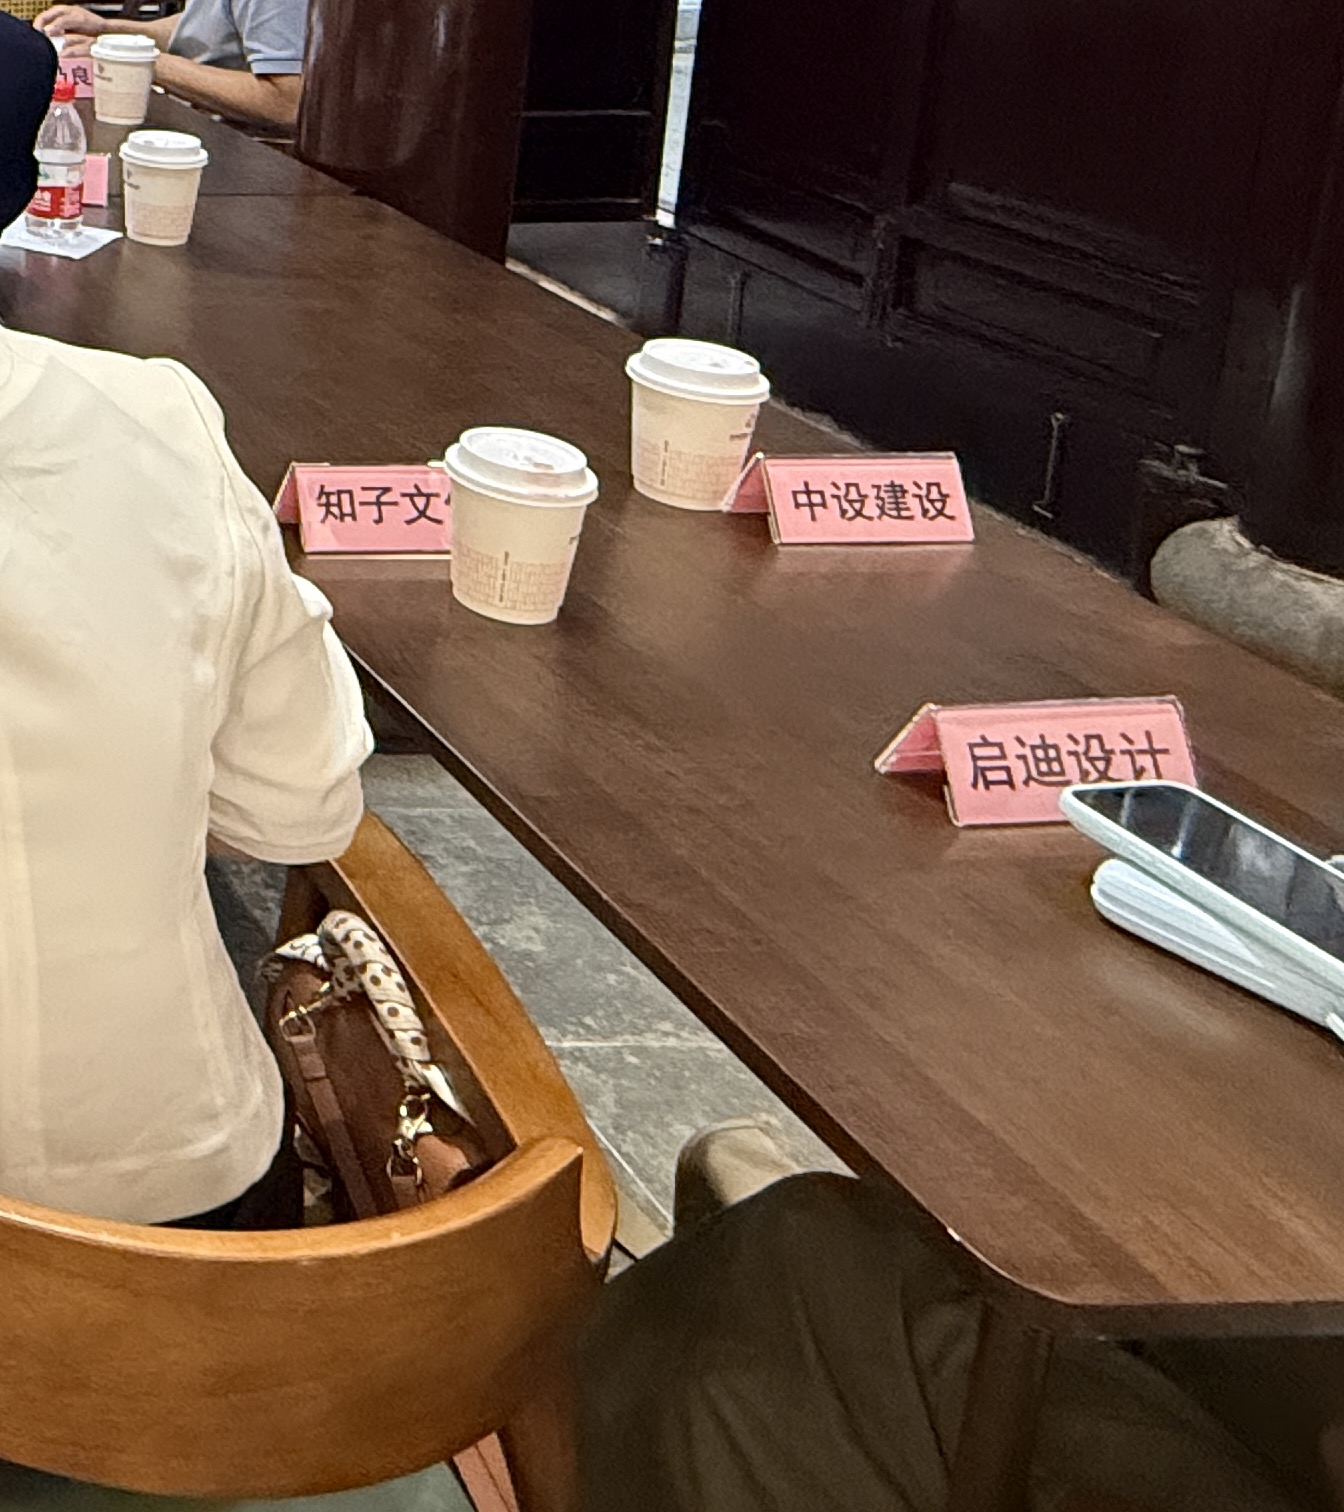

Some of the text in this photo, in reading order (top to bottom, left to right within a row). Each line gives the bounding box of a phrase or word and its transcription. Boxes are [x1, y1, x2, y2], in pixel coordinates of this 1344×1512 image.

[316, 483, 452, 525] 知子文
[791, 480, 956, 522] 中设建设
[967, 730, 1170, 791] 启迪设计
